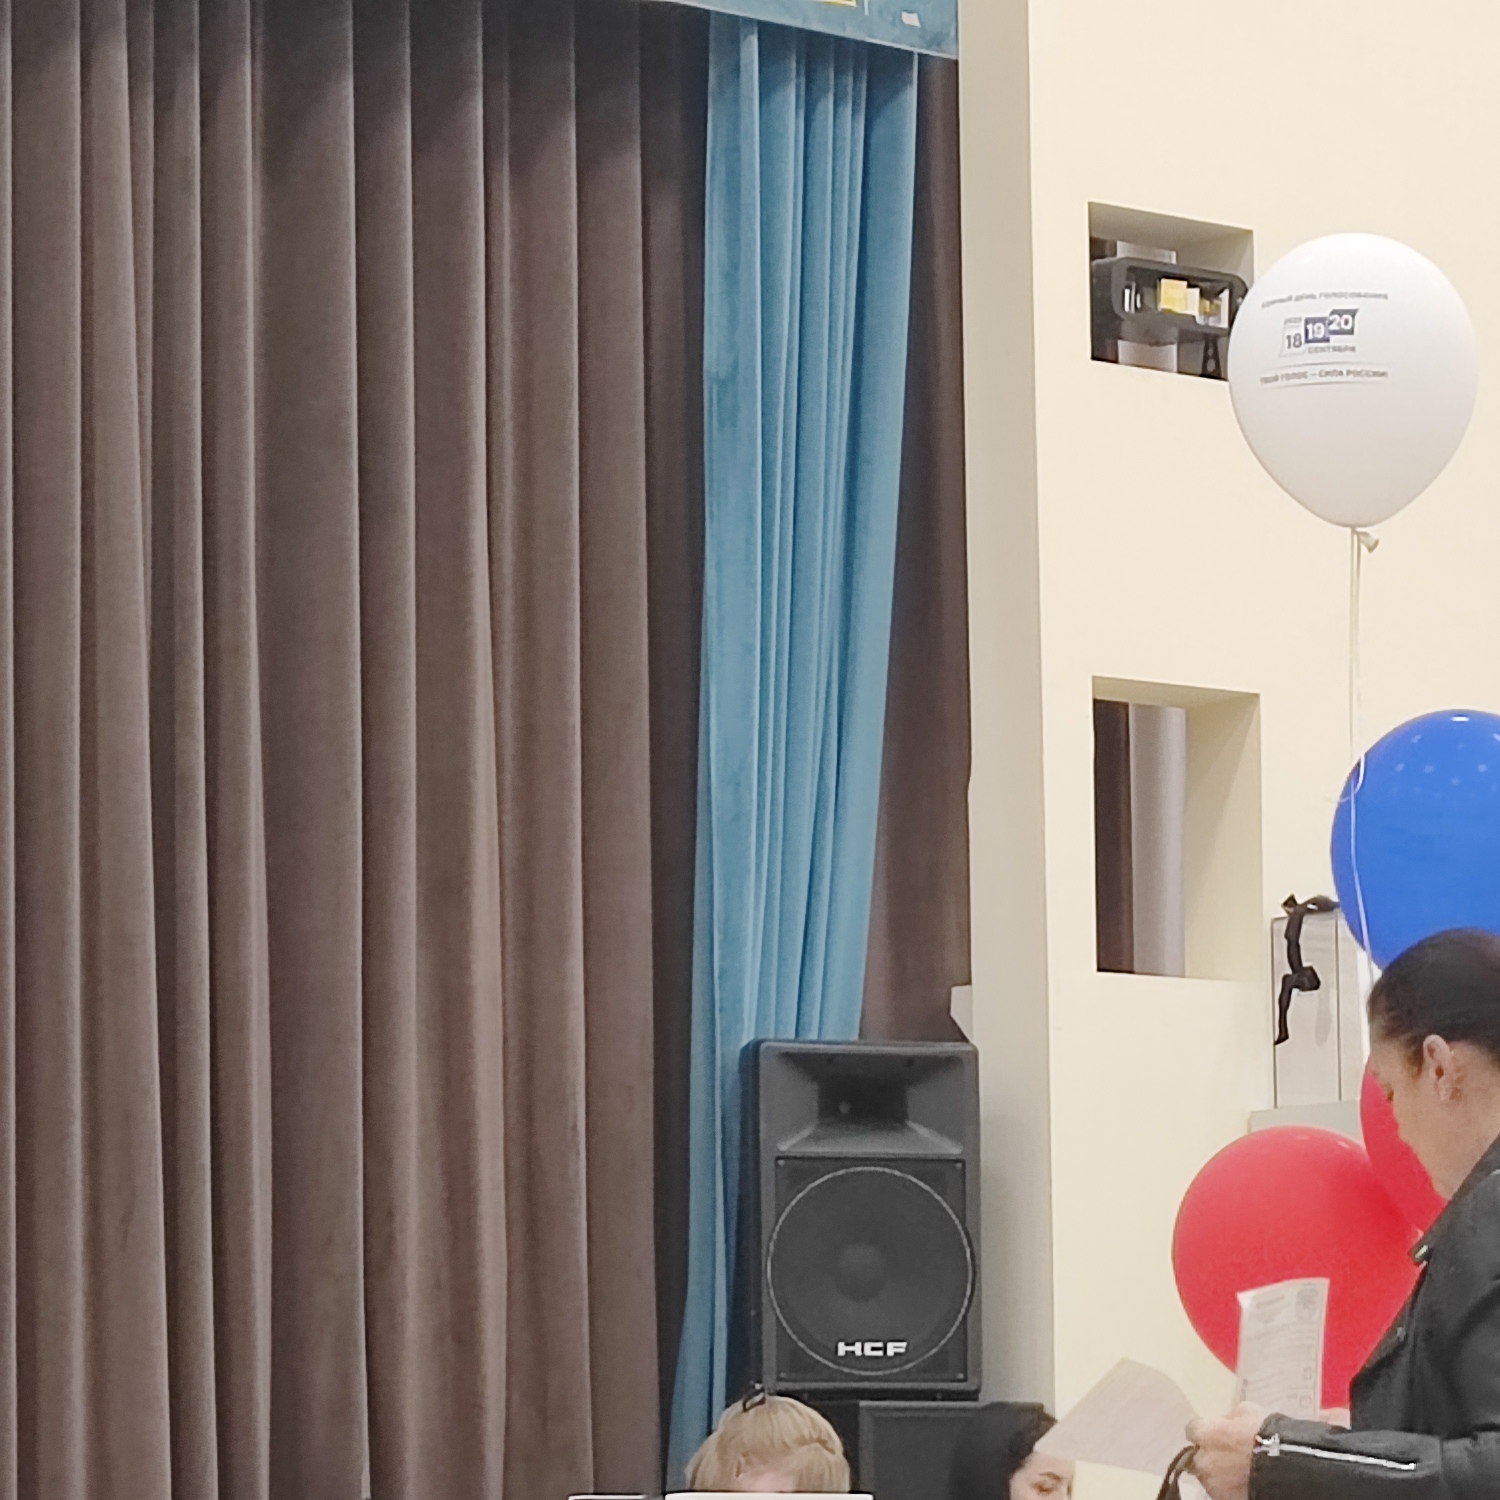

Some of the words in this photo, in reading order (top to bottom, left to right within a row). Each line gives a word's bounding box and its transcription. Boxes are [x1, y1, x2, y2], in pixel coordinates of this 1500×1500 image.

[1286, 333, 1303, 350] 18
[1328, 314, 1353, 331] 20
[837, 1341, 907, 1357] HCF
